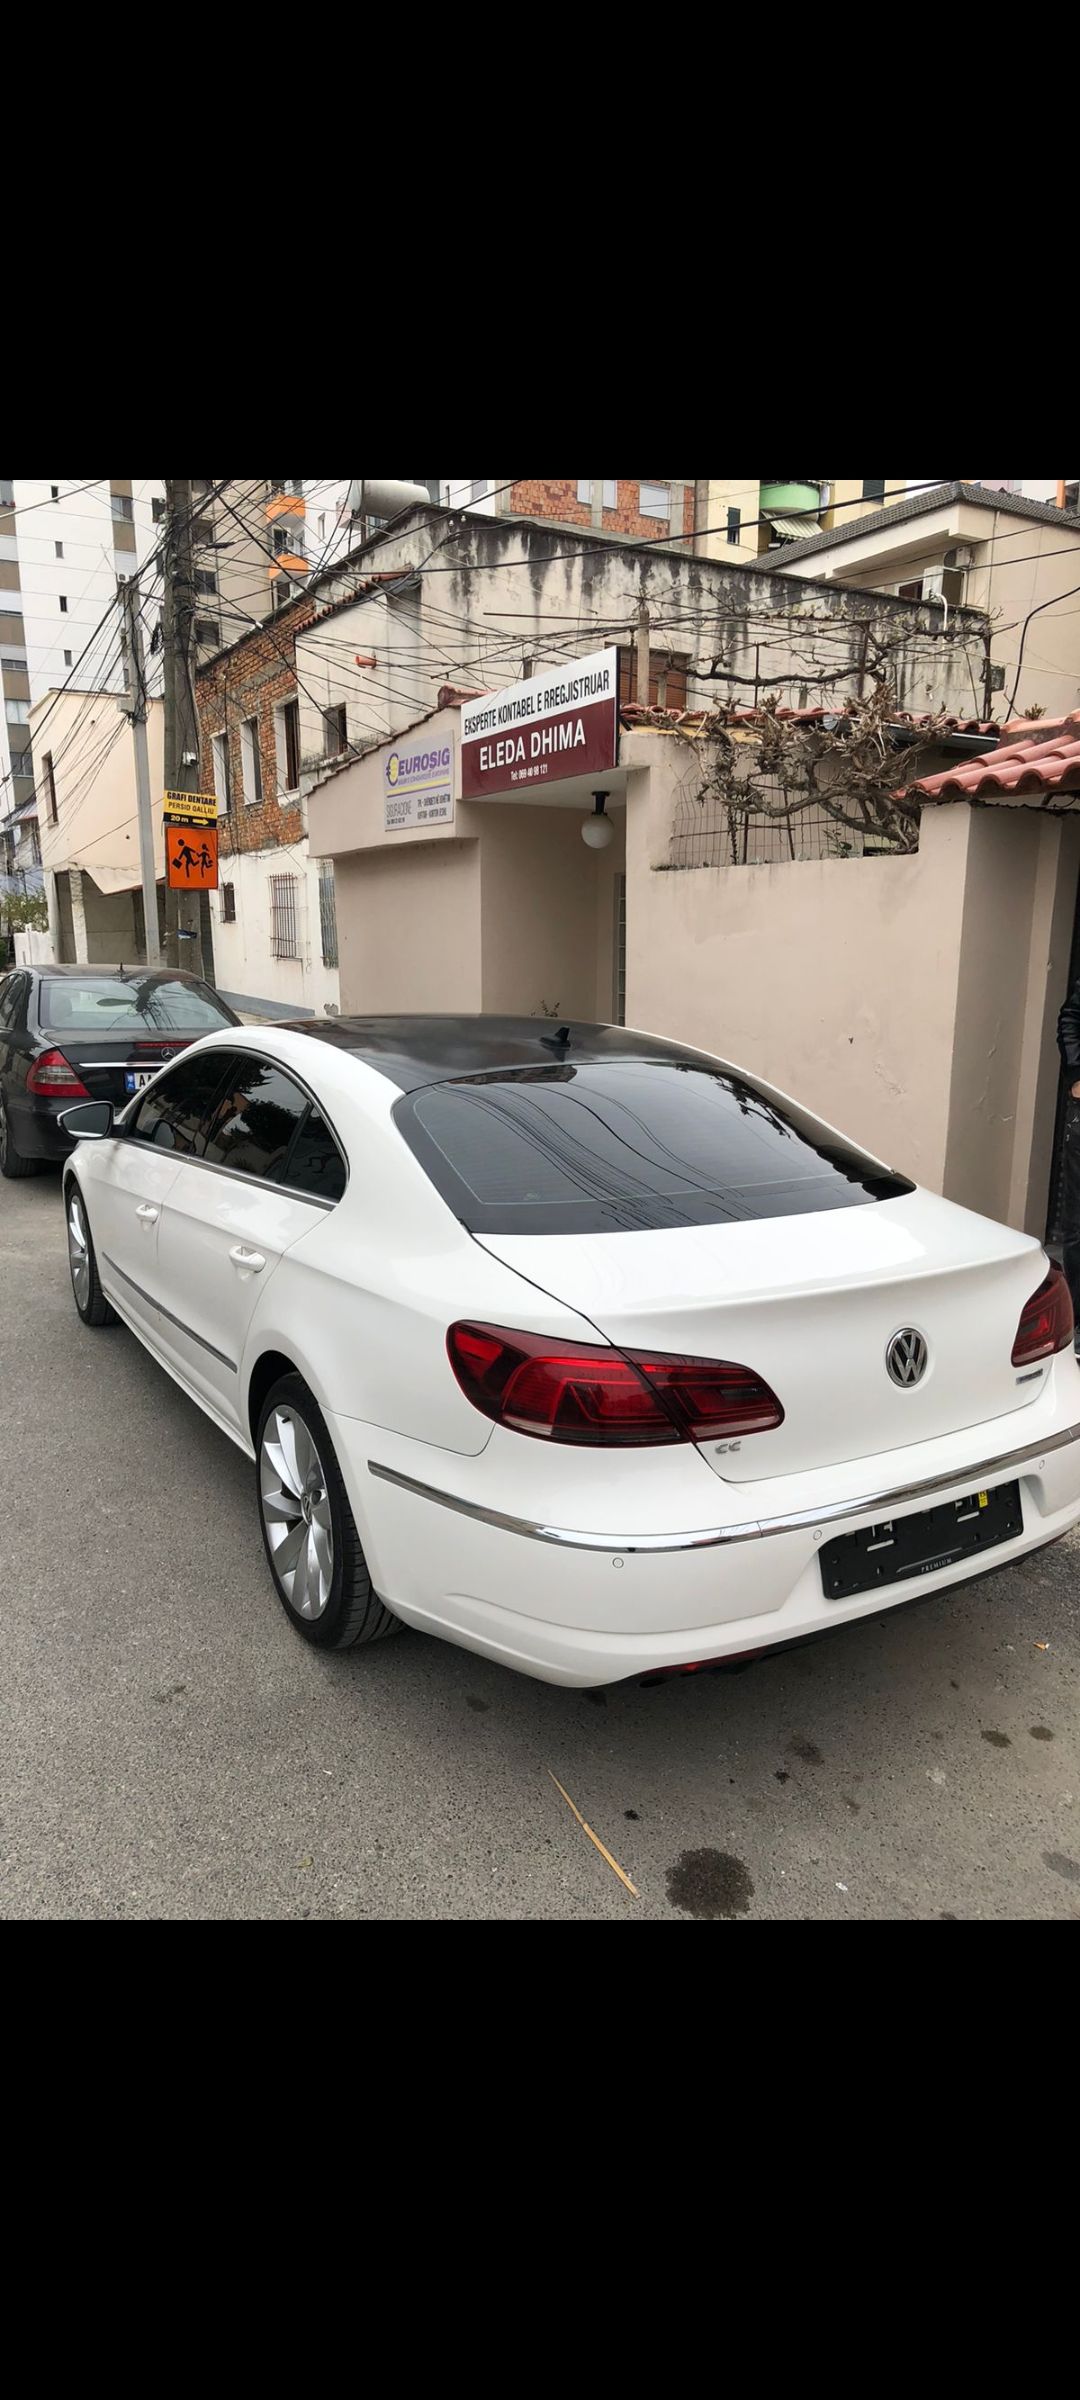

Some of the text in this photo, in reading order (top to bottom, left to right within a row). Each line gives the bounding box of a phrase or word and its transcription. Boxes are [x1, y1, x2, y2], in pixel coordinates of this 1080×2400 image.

[464, 669, 610, 736] EKSPERTE KONTABEL E RREGJISTRUAR
[479, 718, 586, 771] ELEDA DHIMA
[398, 747, 450, 777] EUROSIG
[188, 795, 216, 806] DENTARE
[170, 814, 181, 822] 20
[715, 1440, 742, 1455] CC
[921, 1558, 952, 1573] PREMIUM
